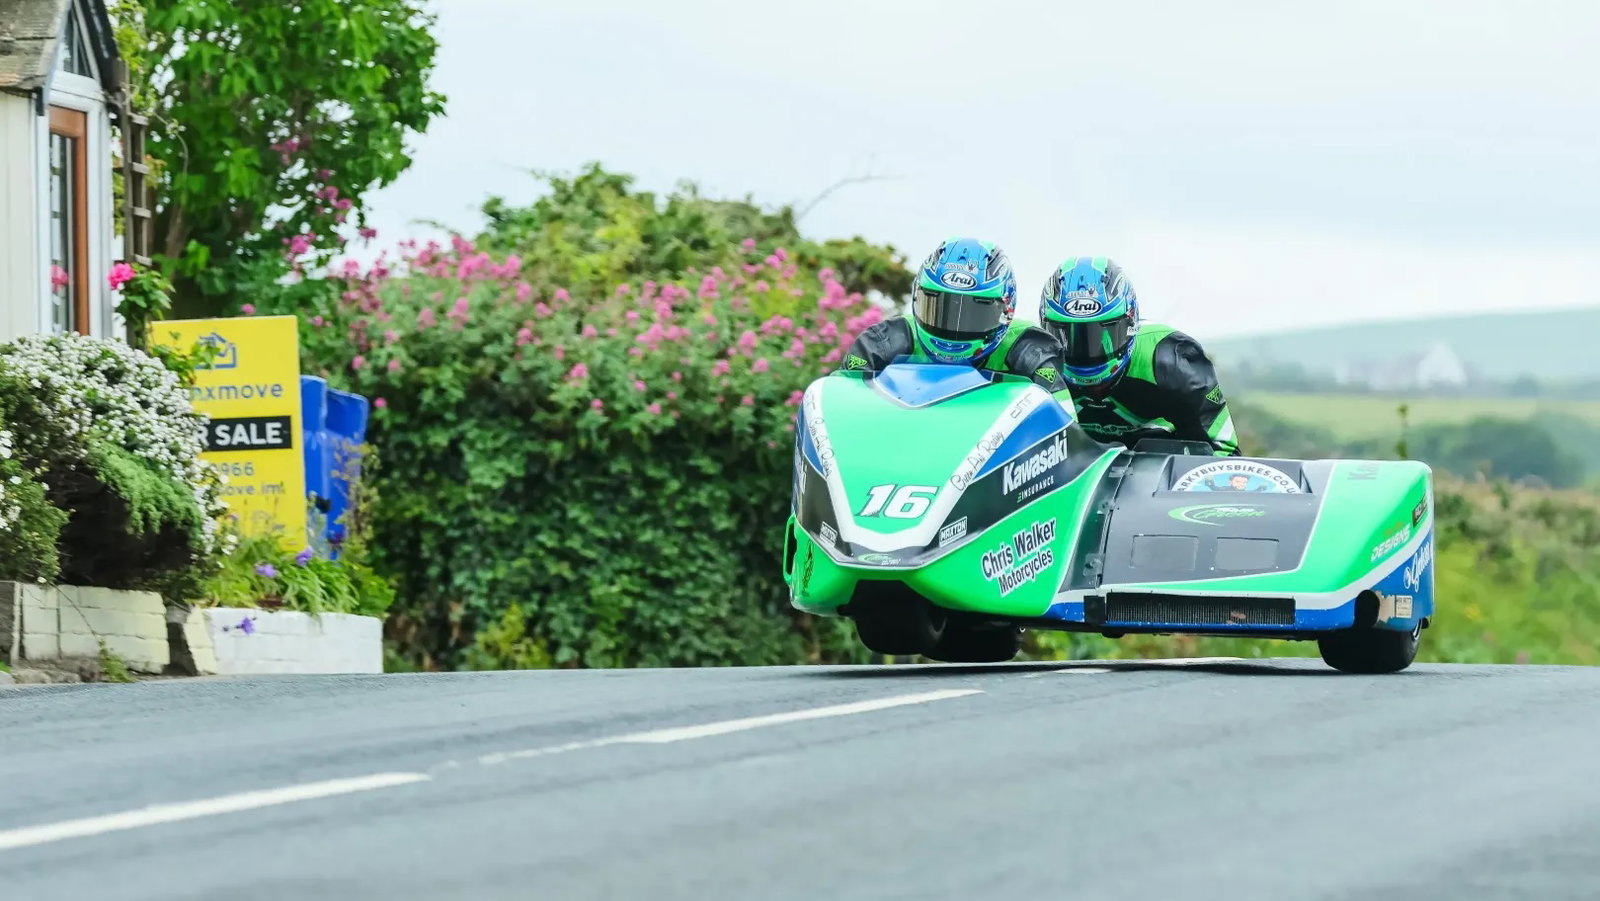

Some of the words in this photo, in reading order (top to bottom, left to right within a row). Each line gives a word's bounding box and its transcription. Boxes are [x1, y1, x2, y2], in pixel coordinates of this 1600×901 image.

[943, 272, 973, 286] Arai
[1069, 300, 1097, 311] Arai
[215, 422, 284, 446] SALE
[1003, 429, 1068, 495] Kawasaki
[1021, 475, 1055, 500] INSURANCE
[854, 483, 940, 519] 16
[940, 519, 966, 541] MAXTON
[982, 545, 1013, 579] Chris
[1014, 519, 1056, 558] Walker
[998, 550, 1053, 594] Motorcycles
